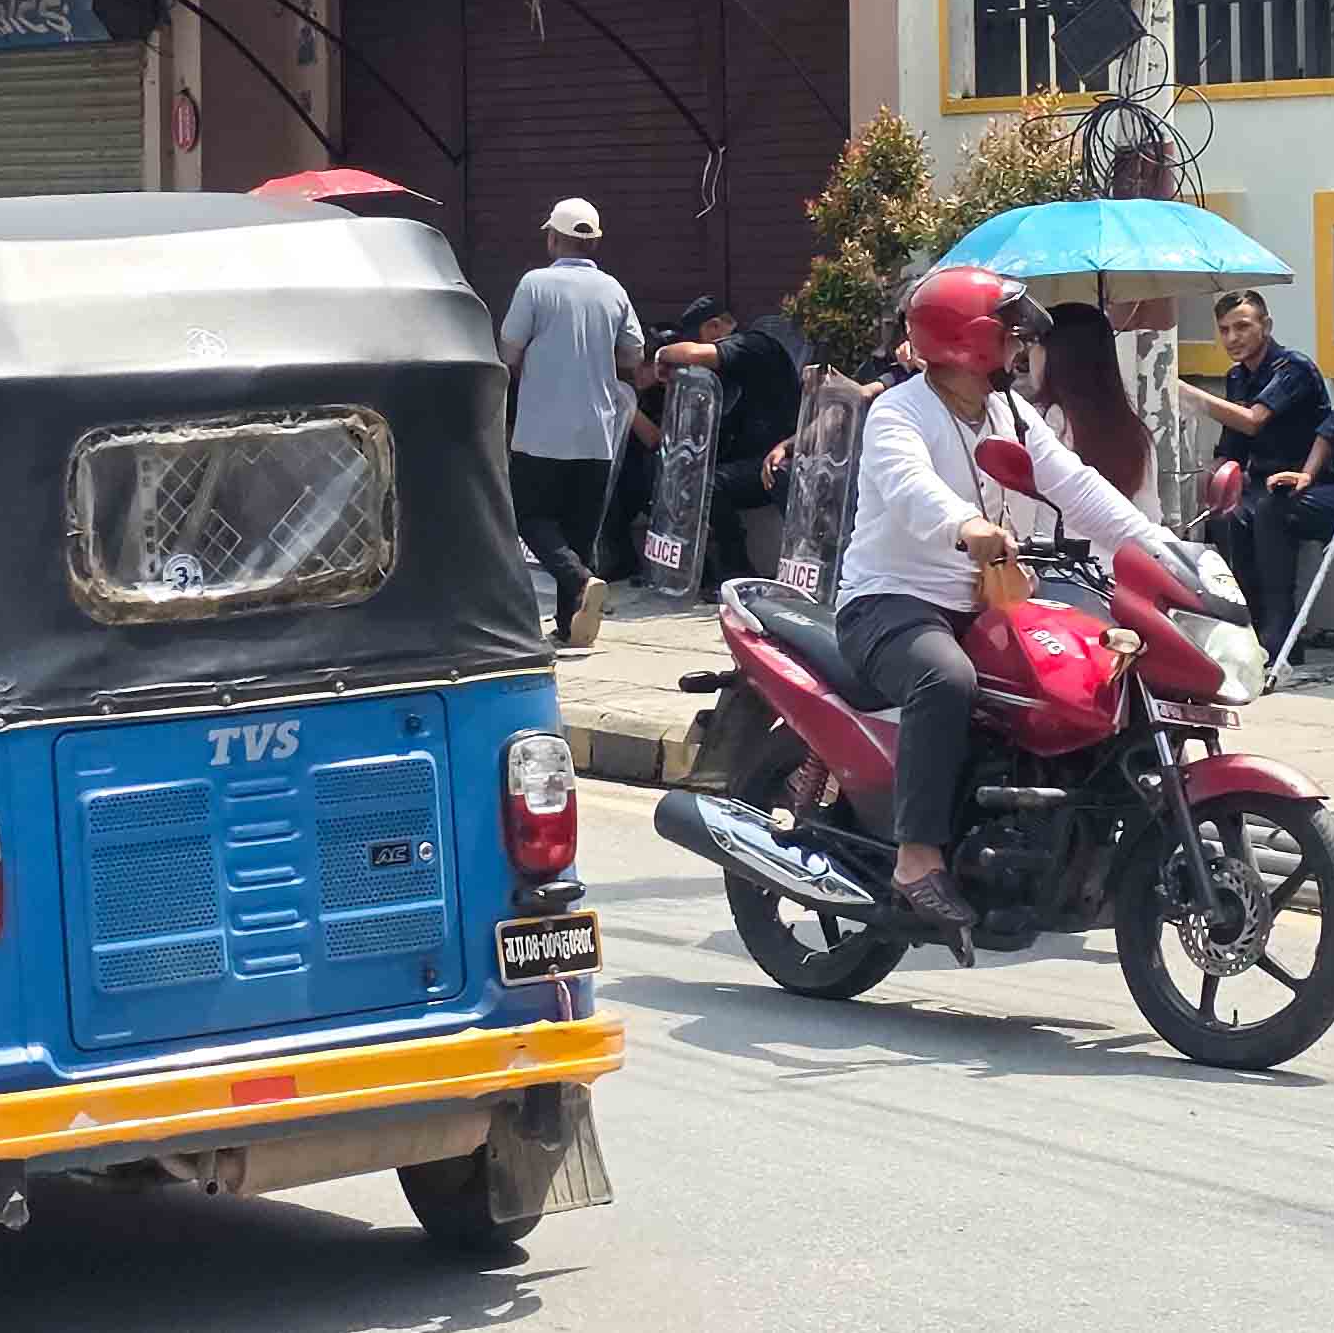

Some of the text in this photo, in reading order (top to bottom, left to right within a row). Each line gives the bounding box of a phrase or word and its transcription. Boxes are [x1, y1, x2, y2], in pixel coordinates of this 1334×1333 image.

[645, 533, 680, 565] POLICE
[779, 560, 817, 589] POLICE
[208, 720, 300, 765] TVS
